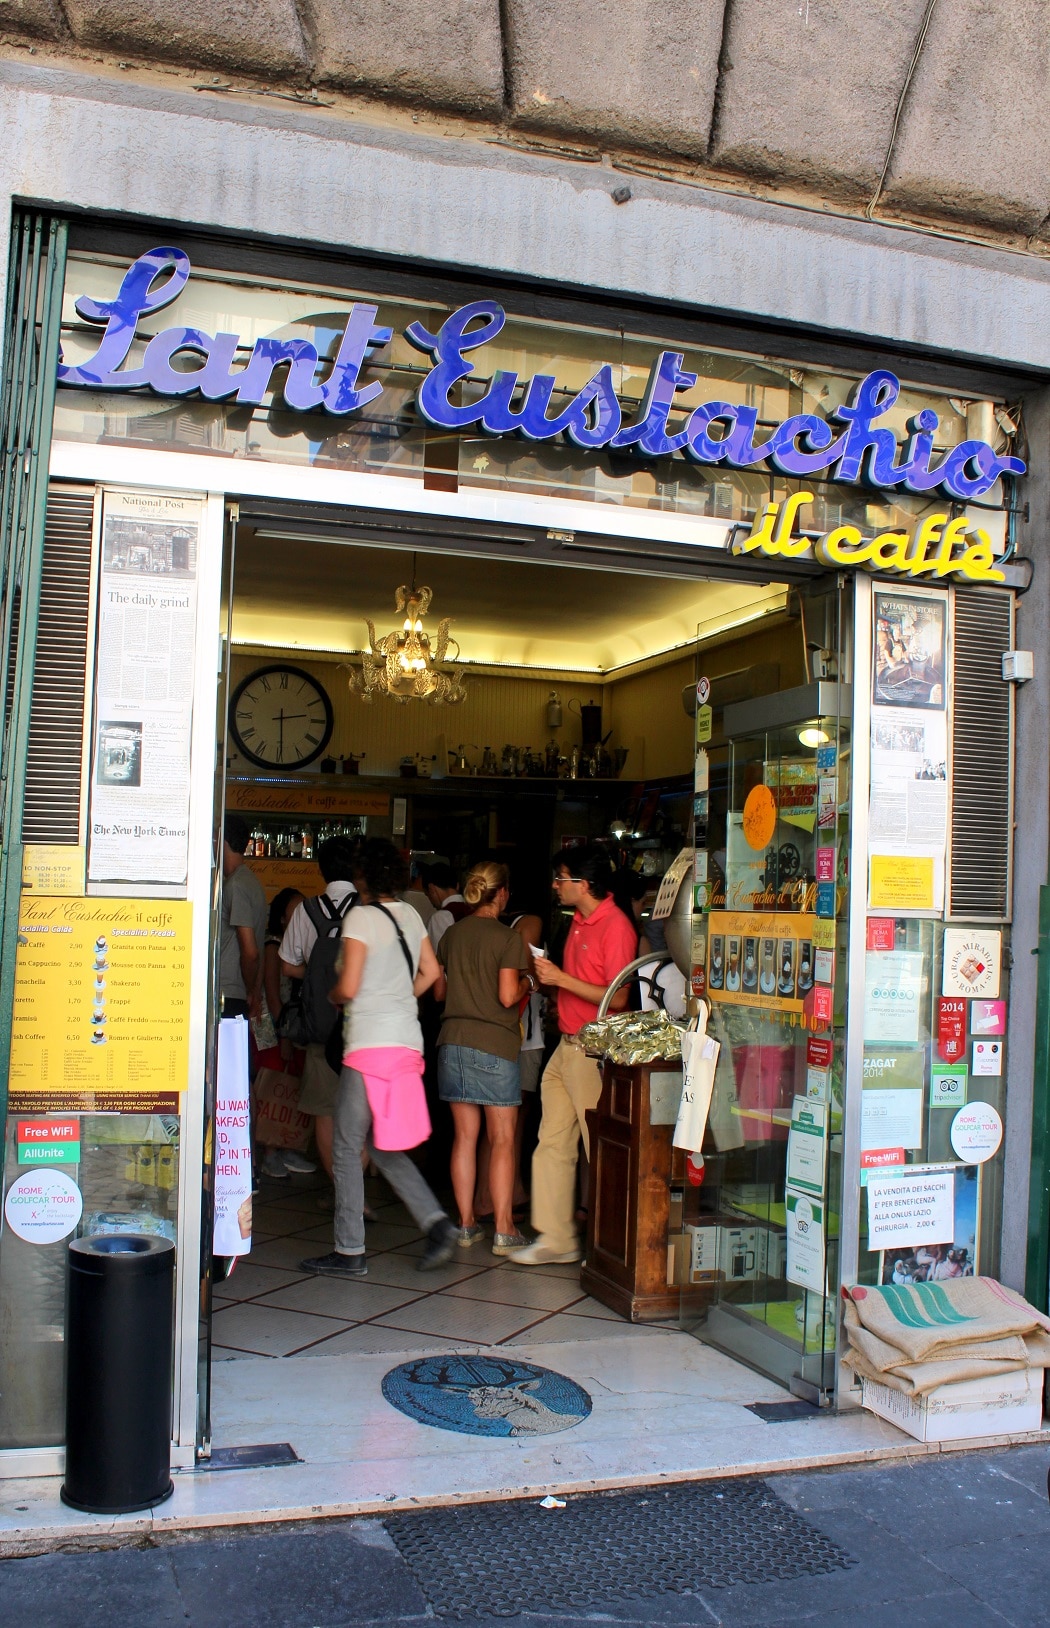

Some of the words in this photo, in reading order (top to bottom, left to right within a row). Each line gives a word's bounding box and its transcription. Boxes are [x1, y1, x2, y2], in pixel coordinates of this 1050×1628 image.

[403, 299, 1026, 499] Eustachio
[122, 496, 161, 507] National
[165, 500, 185, 508] Post
[733, 491, 812, 558] il
[816, 513, 1006, 583] caffè
[107, 591, 130, 604] The
[132, 592, 158, 608] daily
[160, 596, 190, 608] grind
[94, 824, 110, 835] The
[112, 824, 132, 835] New
[134, 826, 156, 838] York
[158, 826, 186, 838] Times
[136, 913, 144, 922] il
[20, 926, 50, 934] ecialità
[52, 926, 74, 934] Calde
[150, 930, 176, 938] Fredde
[958, 982, 986, 994] ROMA
[940, 1002, 965, 1012] 2014
[863, 1058, 898, 1068] ZAGAT
[863, 1068, 884, 1078] 2014
[24, 1127, 48, 1137] Free
[51, 1126, 74, 1137] WiFi
[24, 1148, 65, 1158] AllUnite
[229, 1149, 240, 1160] IN
[216, 1166, 241, 1176] HEN.
[18, 1188, 43, 1196] ROME
[874, 1188, 882, 1196] LA
[883, 1186, 910, 1196] VENDITA
[912, 1184, 923, 1193] DEI
[924, 1184, 946, 1192] SACCHI
[10, 1196, 50, 1205] GOLFCAR
[51, 1196, 76, 1204] TOUR
[874, 1201, 881, 1209] E'
[882, 1200, 893, 1208] PER
[894, 1196, 936, 1207] BENEFICENZA
[874, 1213, 890, 1222] ALLA
[890, 1210, 912, 1220] ONLUS
[914, 1208, 932, 1217] LAZIO
[916, 1220, 931, 1229] 2,00
